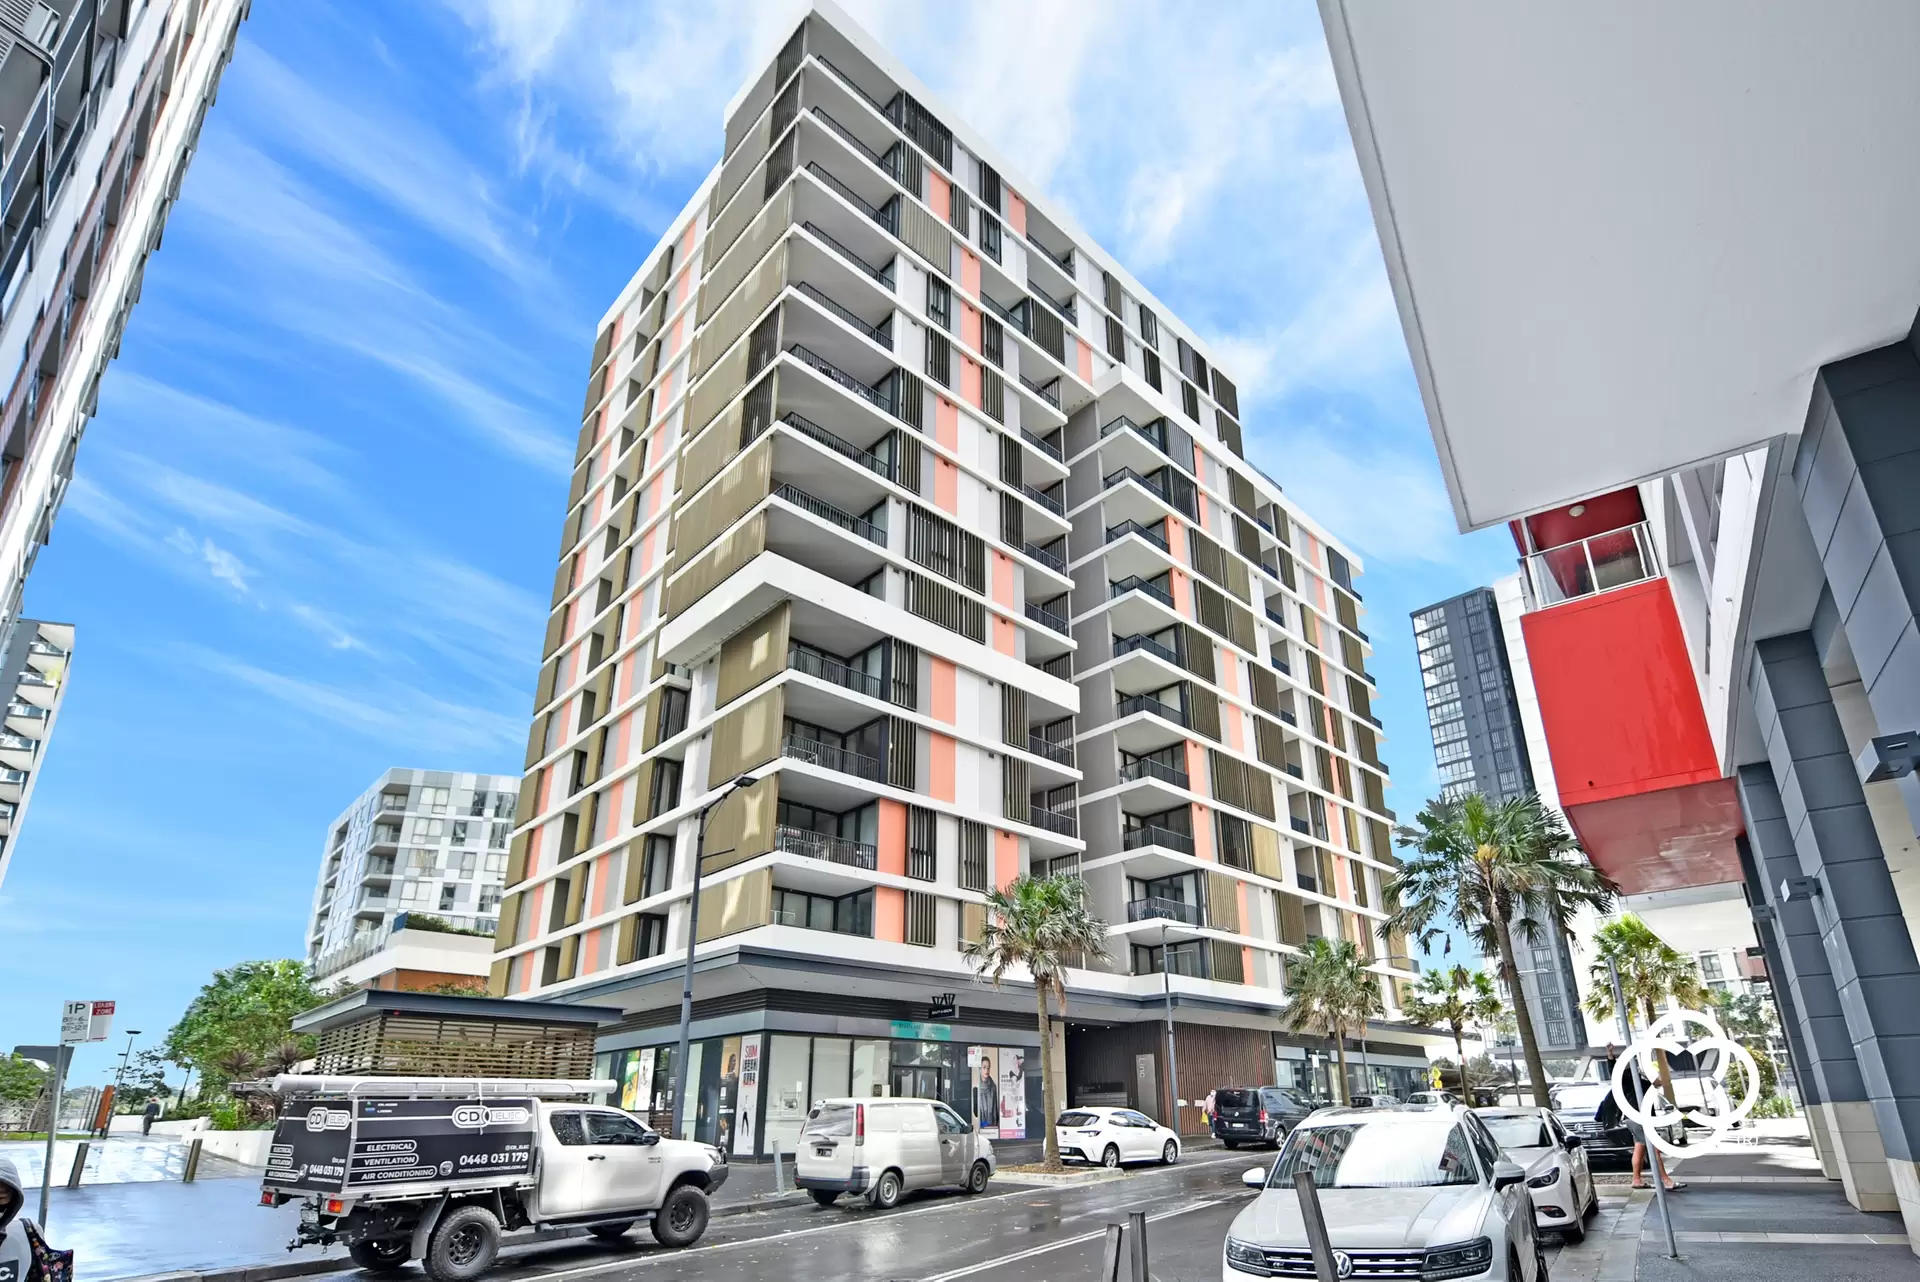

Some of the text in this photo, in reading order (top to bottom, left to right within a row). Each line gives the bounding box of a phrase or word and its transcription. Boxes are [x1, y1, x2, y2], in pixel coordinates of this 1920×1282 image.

[68, 1002, 86, 1014] 1P
[310, 1113, 322, 1125] CD
[457, 1111, 521, 1122] CD ELEC
[366, 1143, 413, 1152] ELECTRICAL
[364, 1156, 415, 1166] VENTILATION
[459, 1152, 529, 1165] 0448 031 179
[309, 1164, 344, 1176] 0448 031 179
[361, 1168, 434, 1181] AIR CONDITIONING
